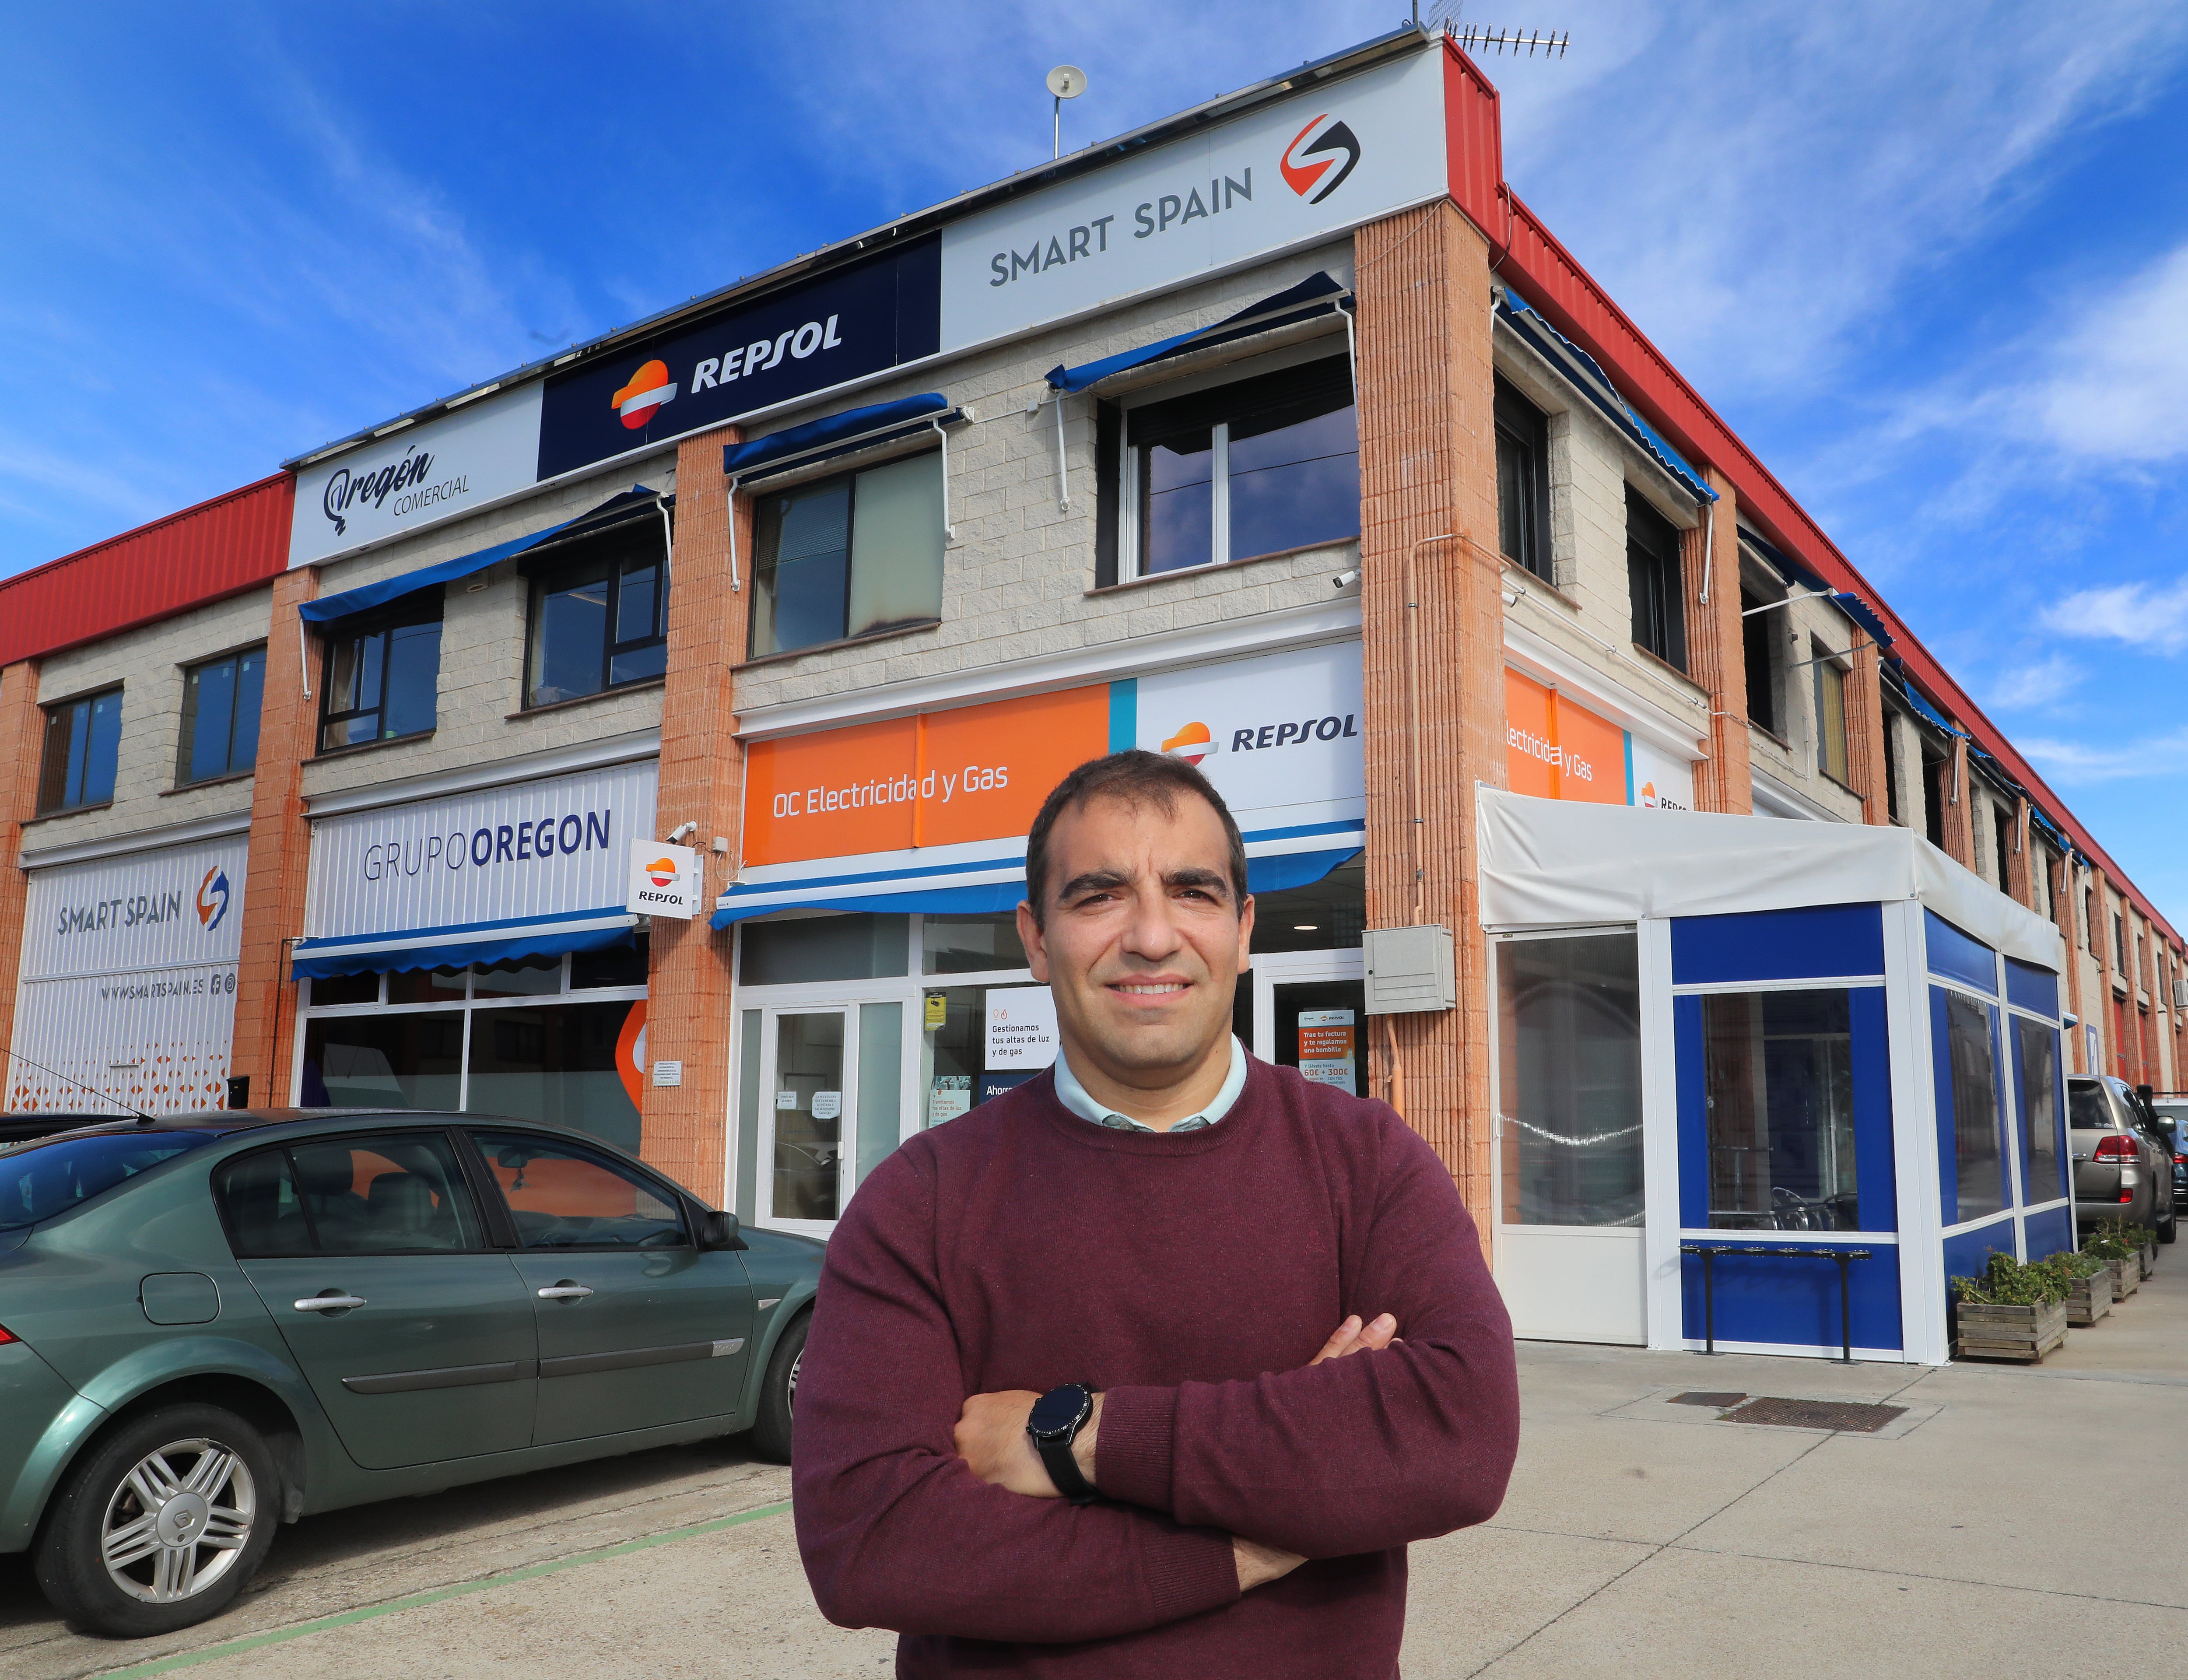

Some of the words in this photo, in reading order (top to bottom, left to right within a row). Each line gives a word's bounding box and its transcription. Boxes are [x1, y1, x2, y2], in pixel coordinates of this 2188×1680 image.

[990, 214, 1114, 287] SMART
[1133, 167, 1252, 239] SPAIN
[691, 314, 842, 393] REPSOL
[394, 475, 469, 516] COMERCIAL
[1231, 714, 1358, 752] REPSOL
[1564, 753, 1571, 777] y
[1574, 754, 1592, 781] Gas
[773, 791, 800, 818] OC
[806, 769, 936, 814] Electricidad
[942, 773, 957, 803] y
[963, 765, 1008, 793] Gas
[57, 899, 122, 935] SMART
[124, 890, 182, 927] SPAIN
[638, 891, 684, 905] REPSOL
[1010, 1049, 1022, 1057] gas
[986, 1085, 1012, 1095] Ahorr
